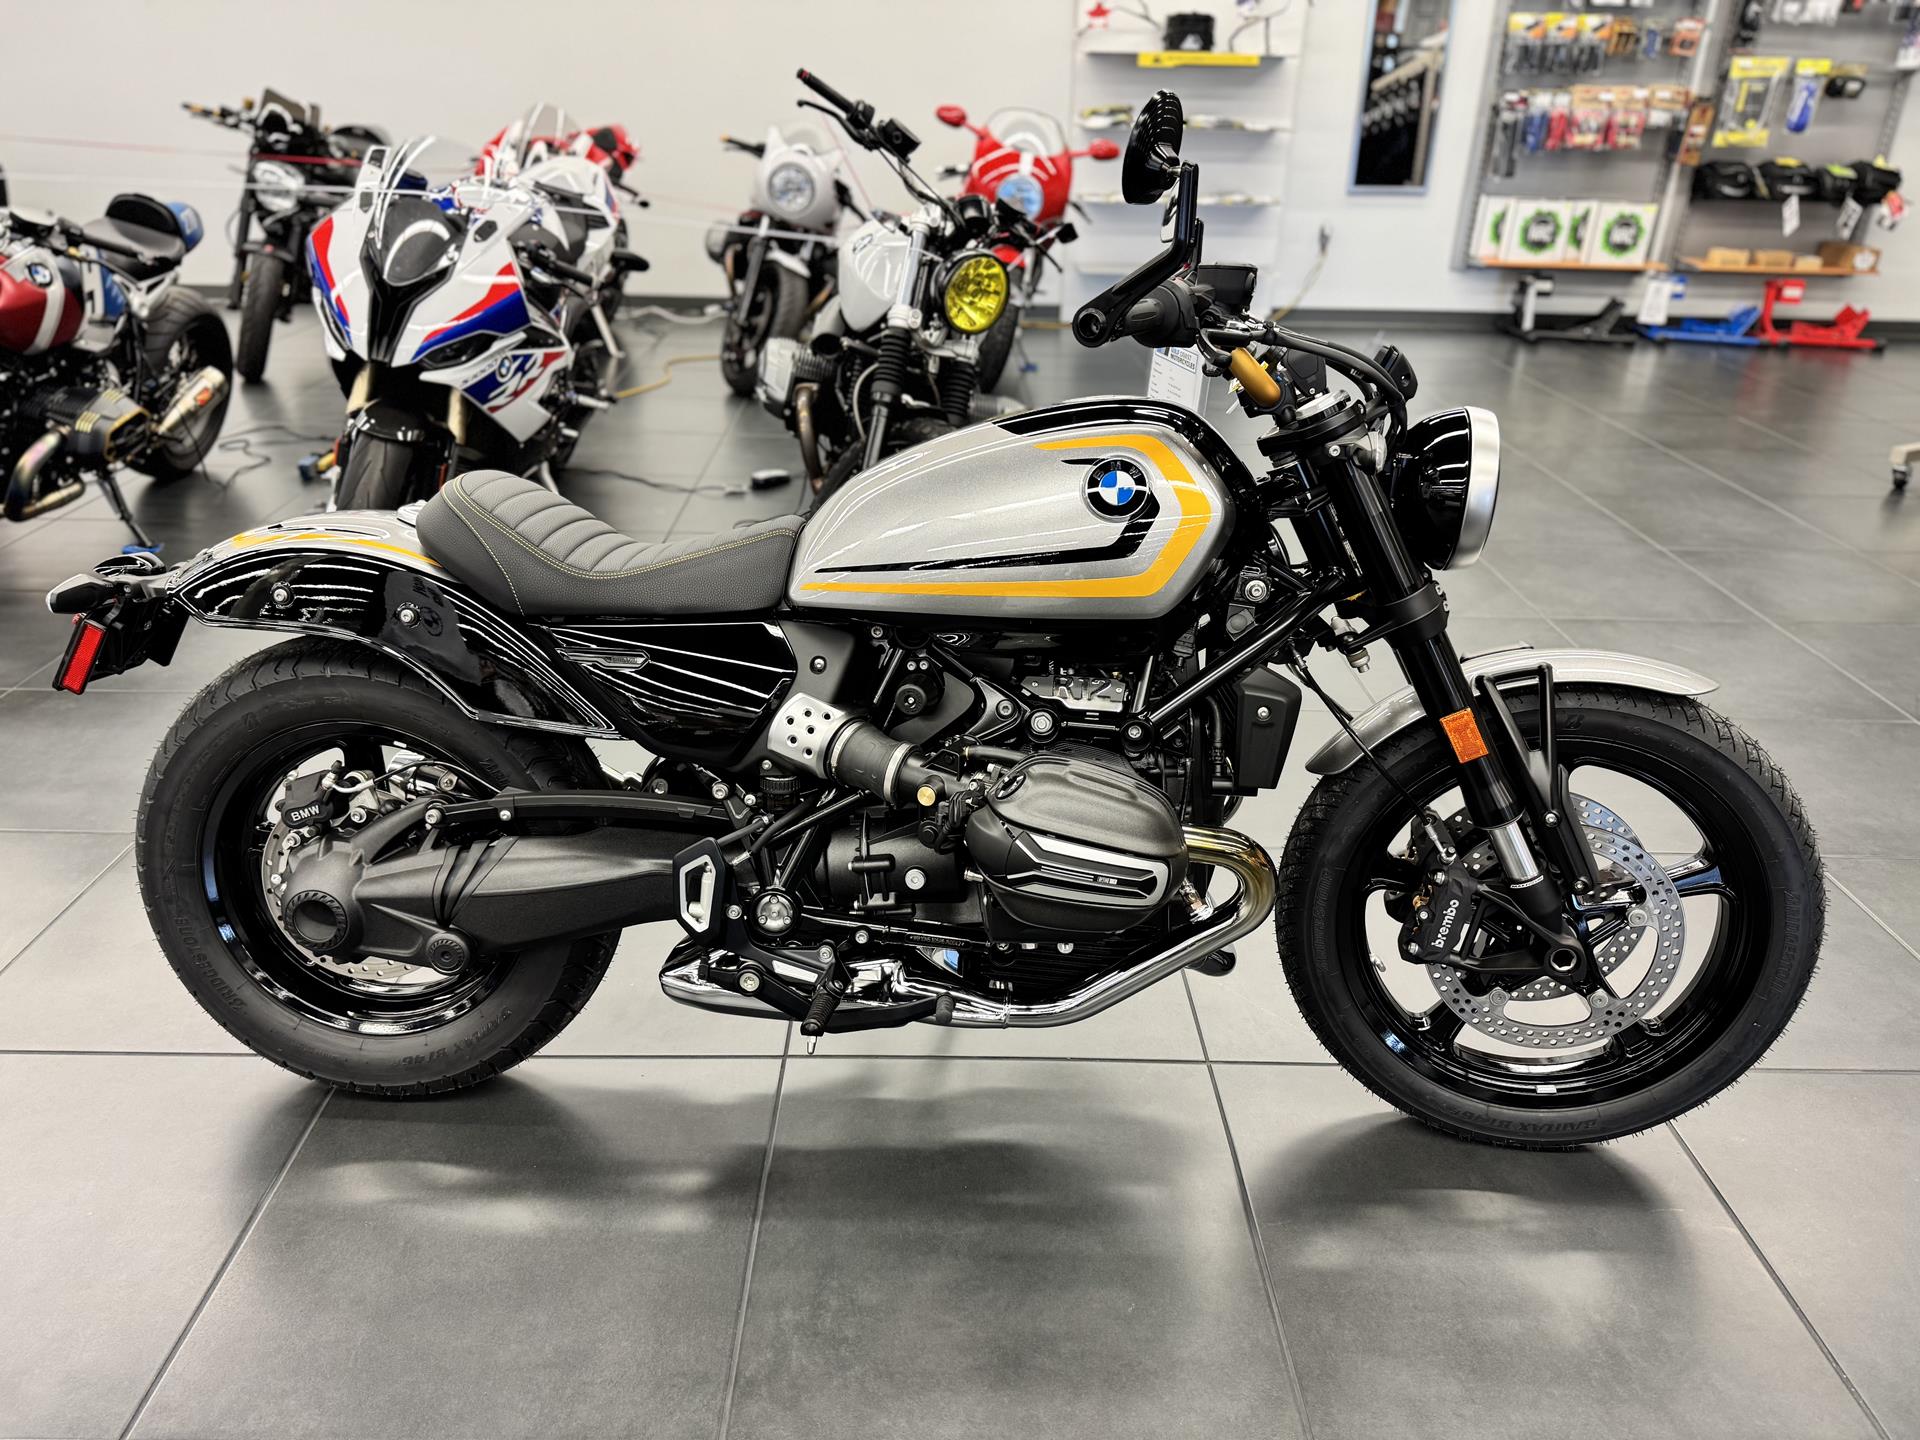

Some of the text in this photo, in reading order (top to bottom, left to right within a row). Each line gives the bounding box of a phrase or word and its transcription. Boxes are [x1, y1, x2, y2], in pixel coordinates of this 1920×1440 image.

[1093, 461, 1142, 481] BMW
[290, 805, 320, 822] BMW
[1432, 898, 1460, 949] brembo
